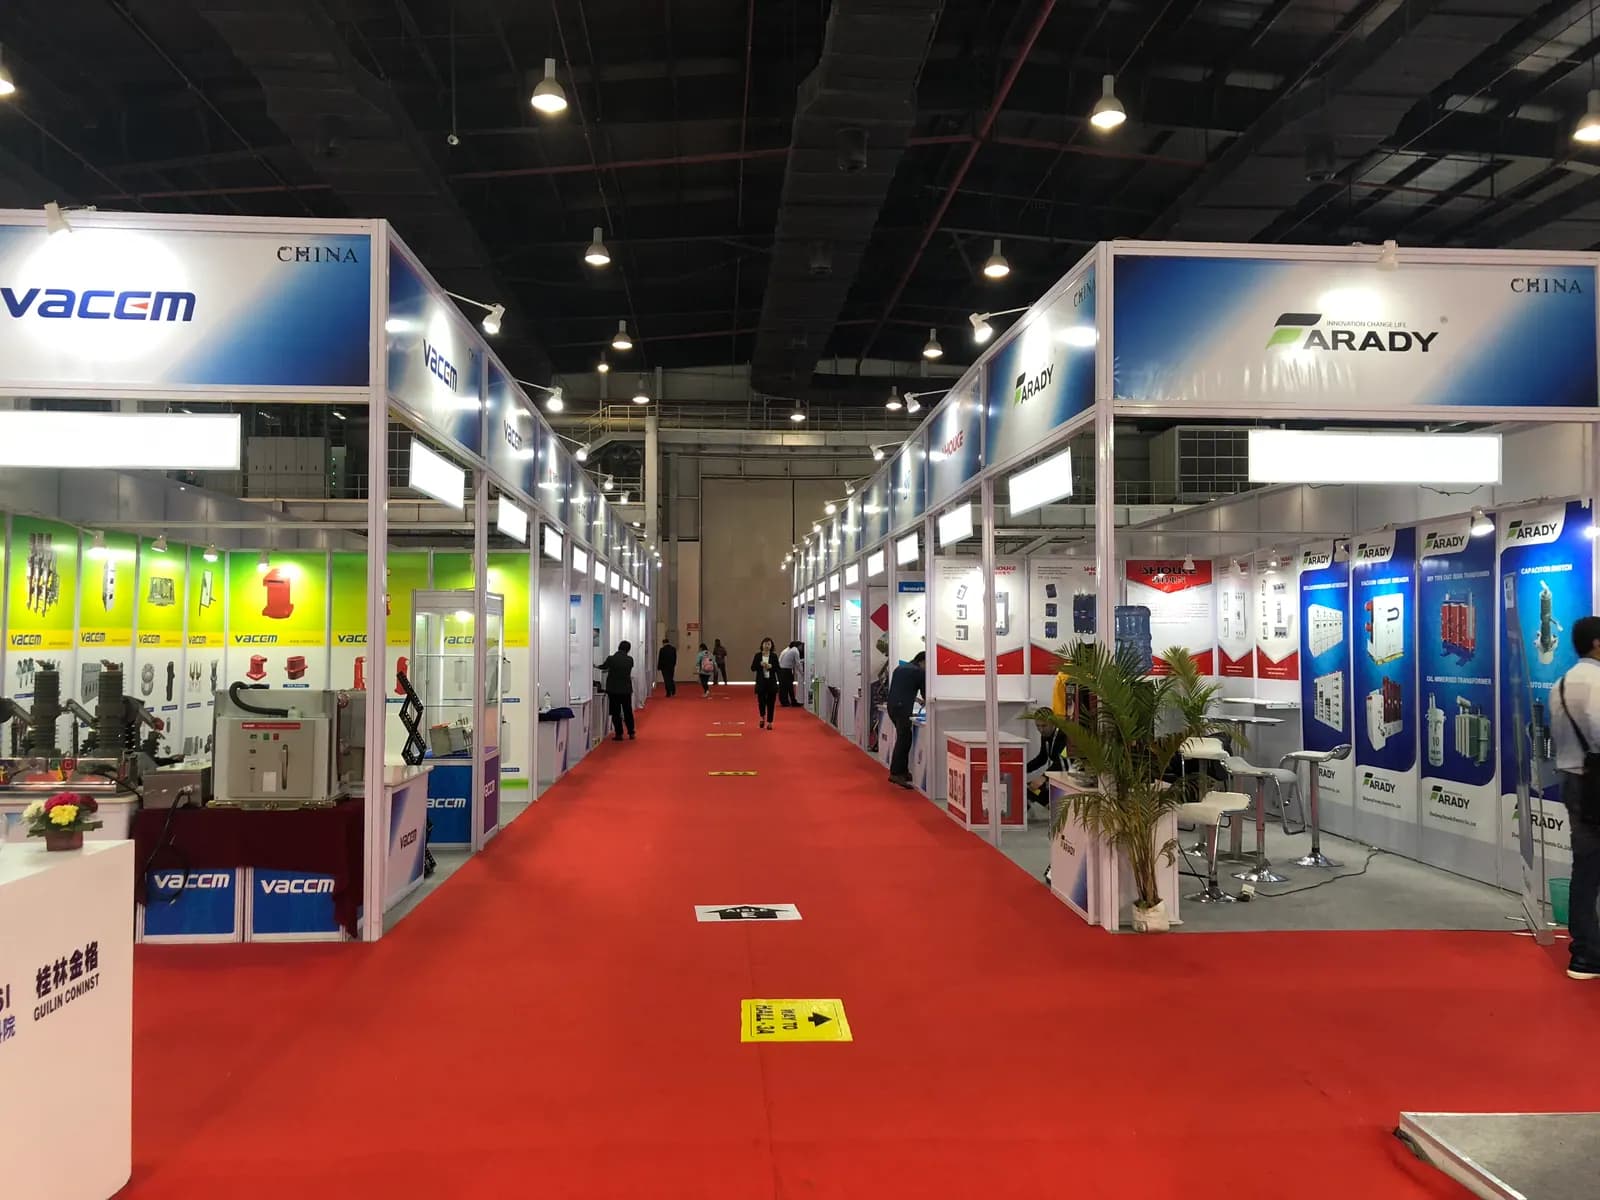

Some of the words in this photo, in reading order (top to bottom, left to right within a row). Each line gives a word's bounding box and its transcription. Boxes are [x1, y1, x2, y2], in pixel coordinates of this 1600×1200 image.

[276, 246, 359, 263] CHINA
[1510, 277, 1583, 295] CHINA
[1326, 320, 1366, 328] INNOVATION
[36, 941, 98, 999] 桂林金格
[34, 993, 63, 1022] GUILIN
[65, 973, 100, 1004] CONINST
